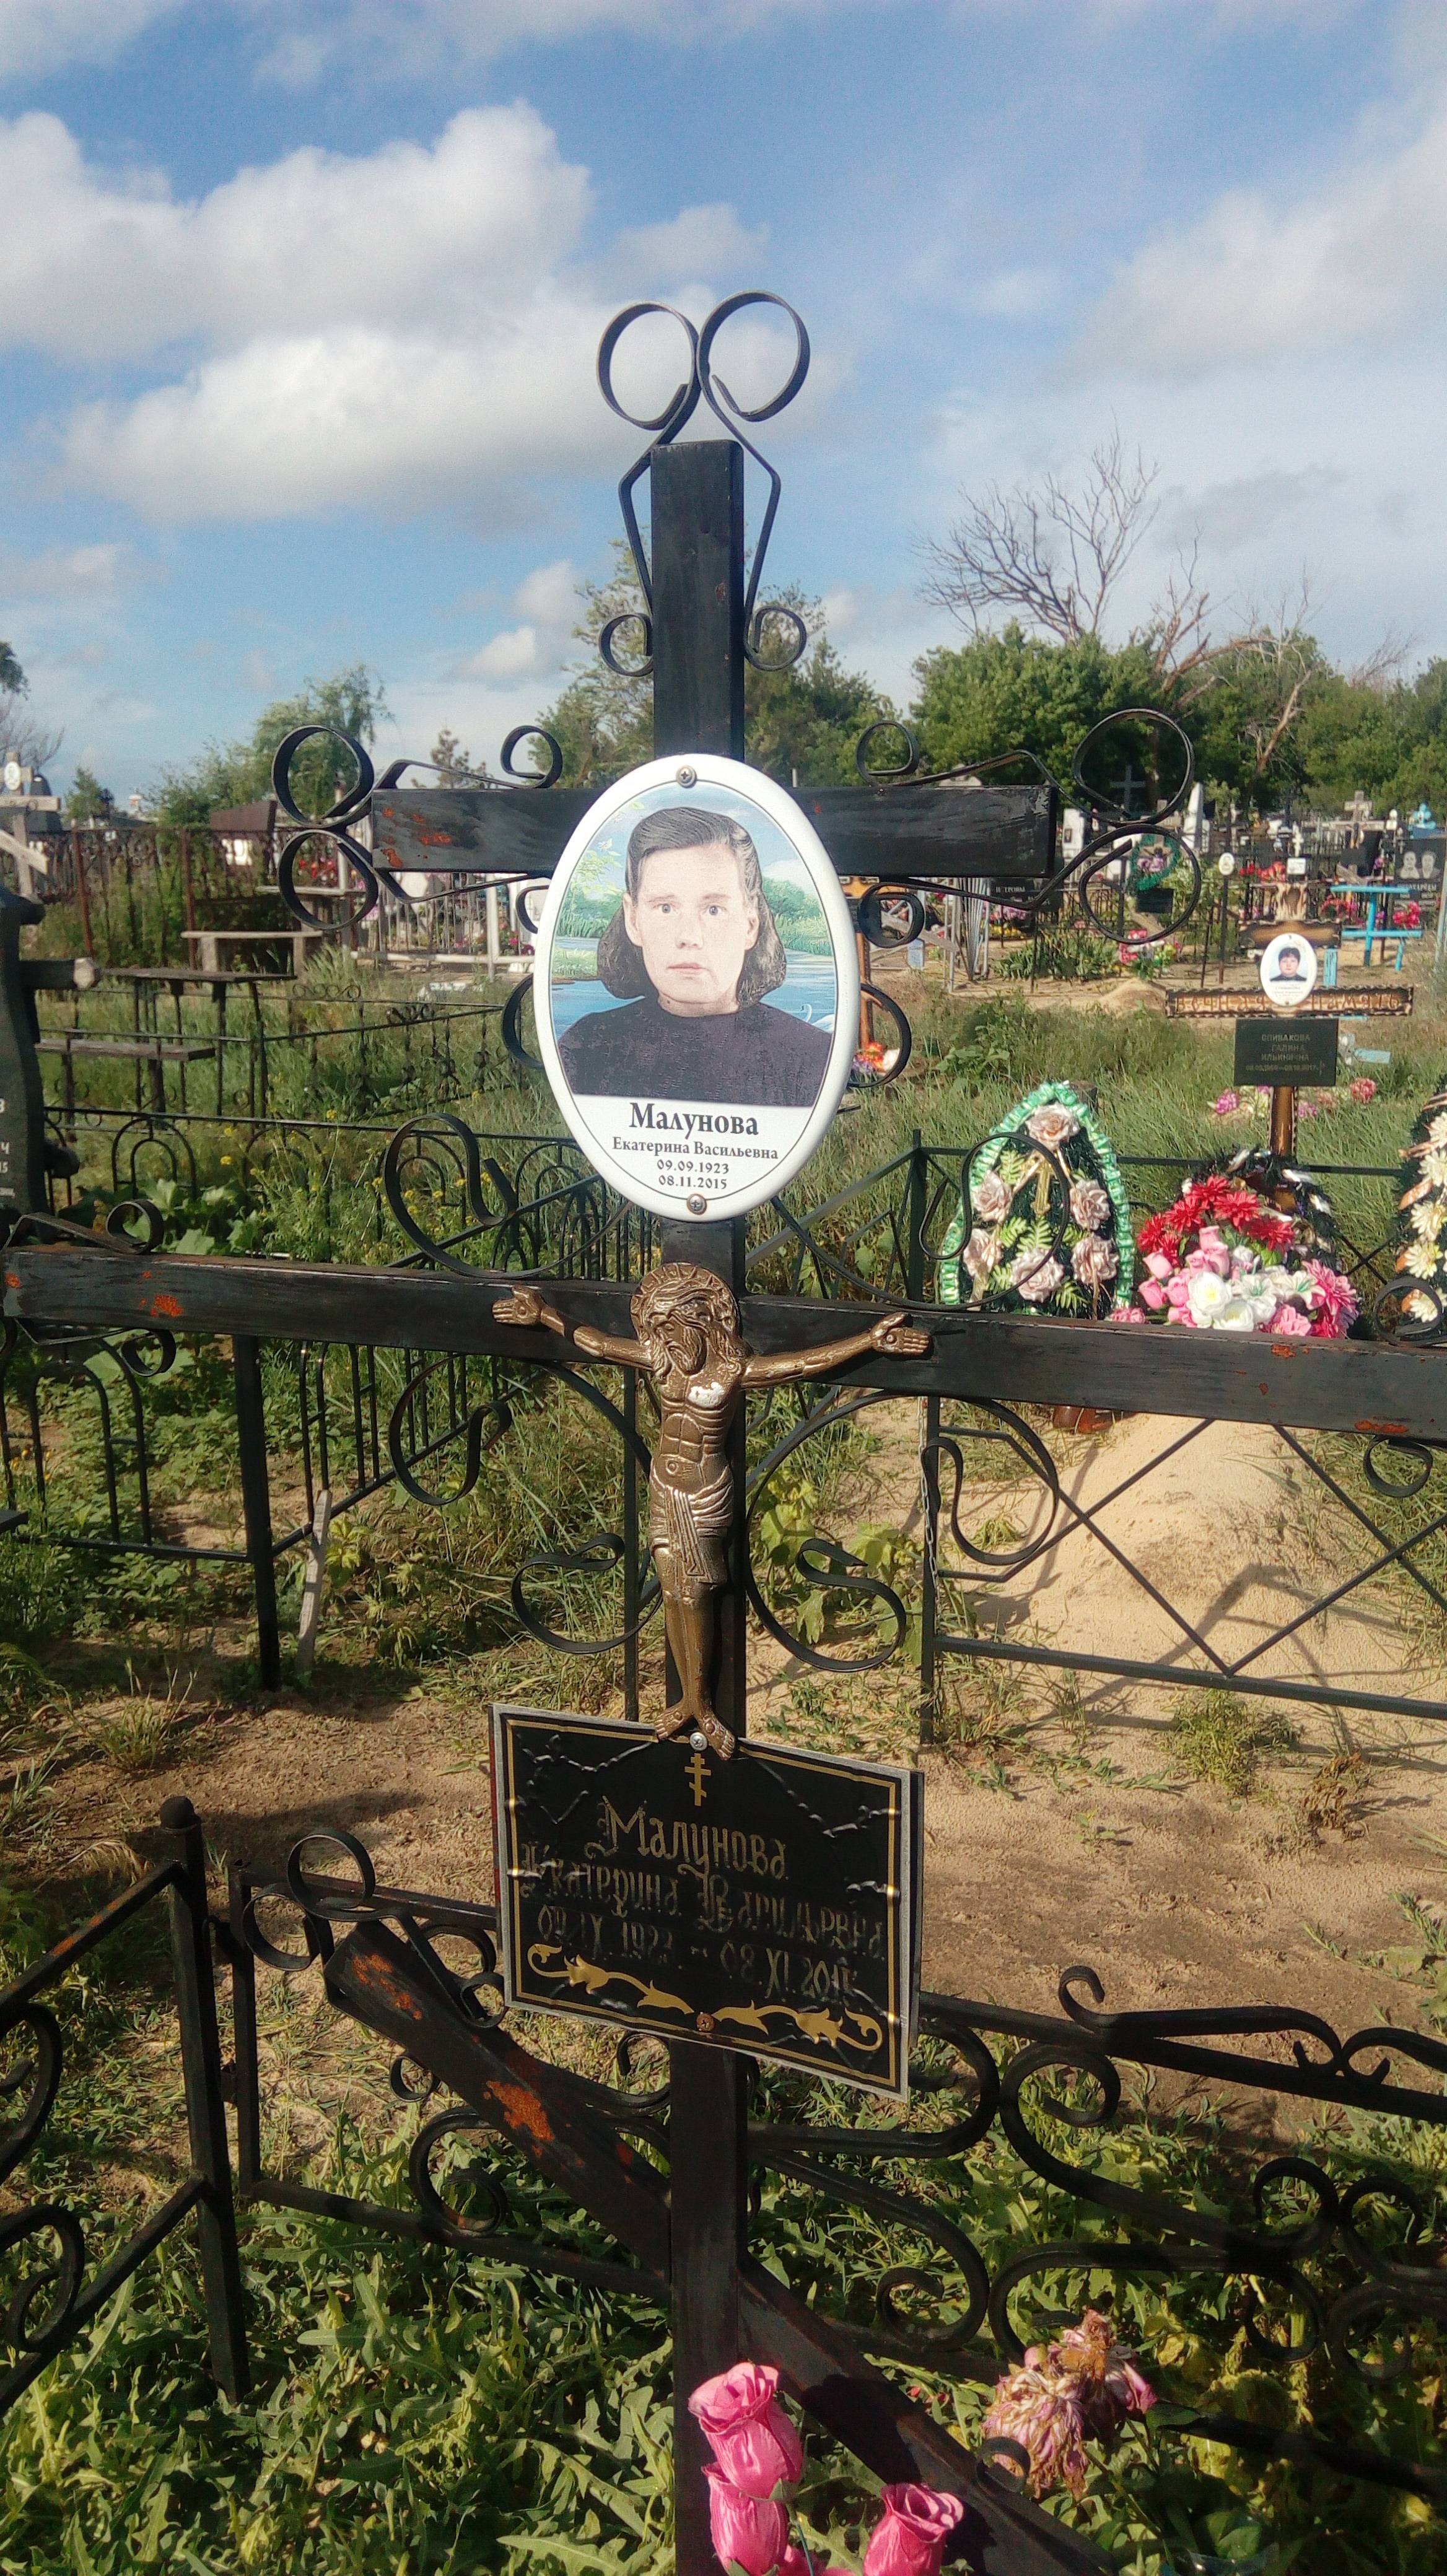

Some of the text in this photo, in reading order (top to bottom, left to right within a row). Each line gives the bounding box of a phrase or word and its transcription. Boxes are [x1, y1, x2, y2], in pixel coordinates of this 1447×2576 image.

[629, 1102, 759, 1140] Малунова
[612, 1137, 779, 1160] Екатерина Васильевна
[657, 1159, 730, 1175] 09.09.1923
[658, 1175, 727, 1190] 08.11.2015
[583, 1795, 785, 1881] Малунова
